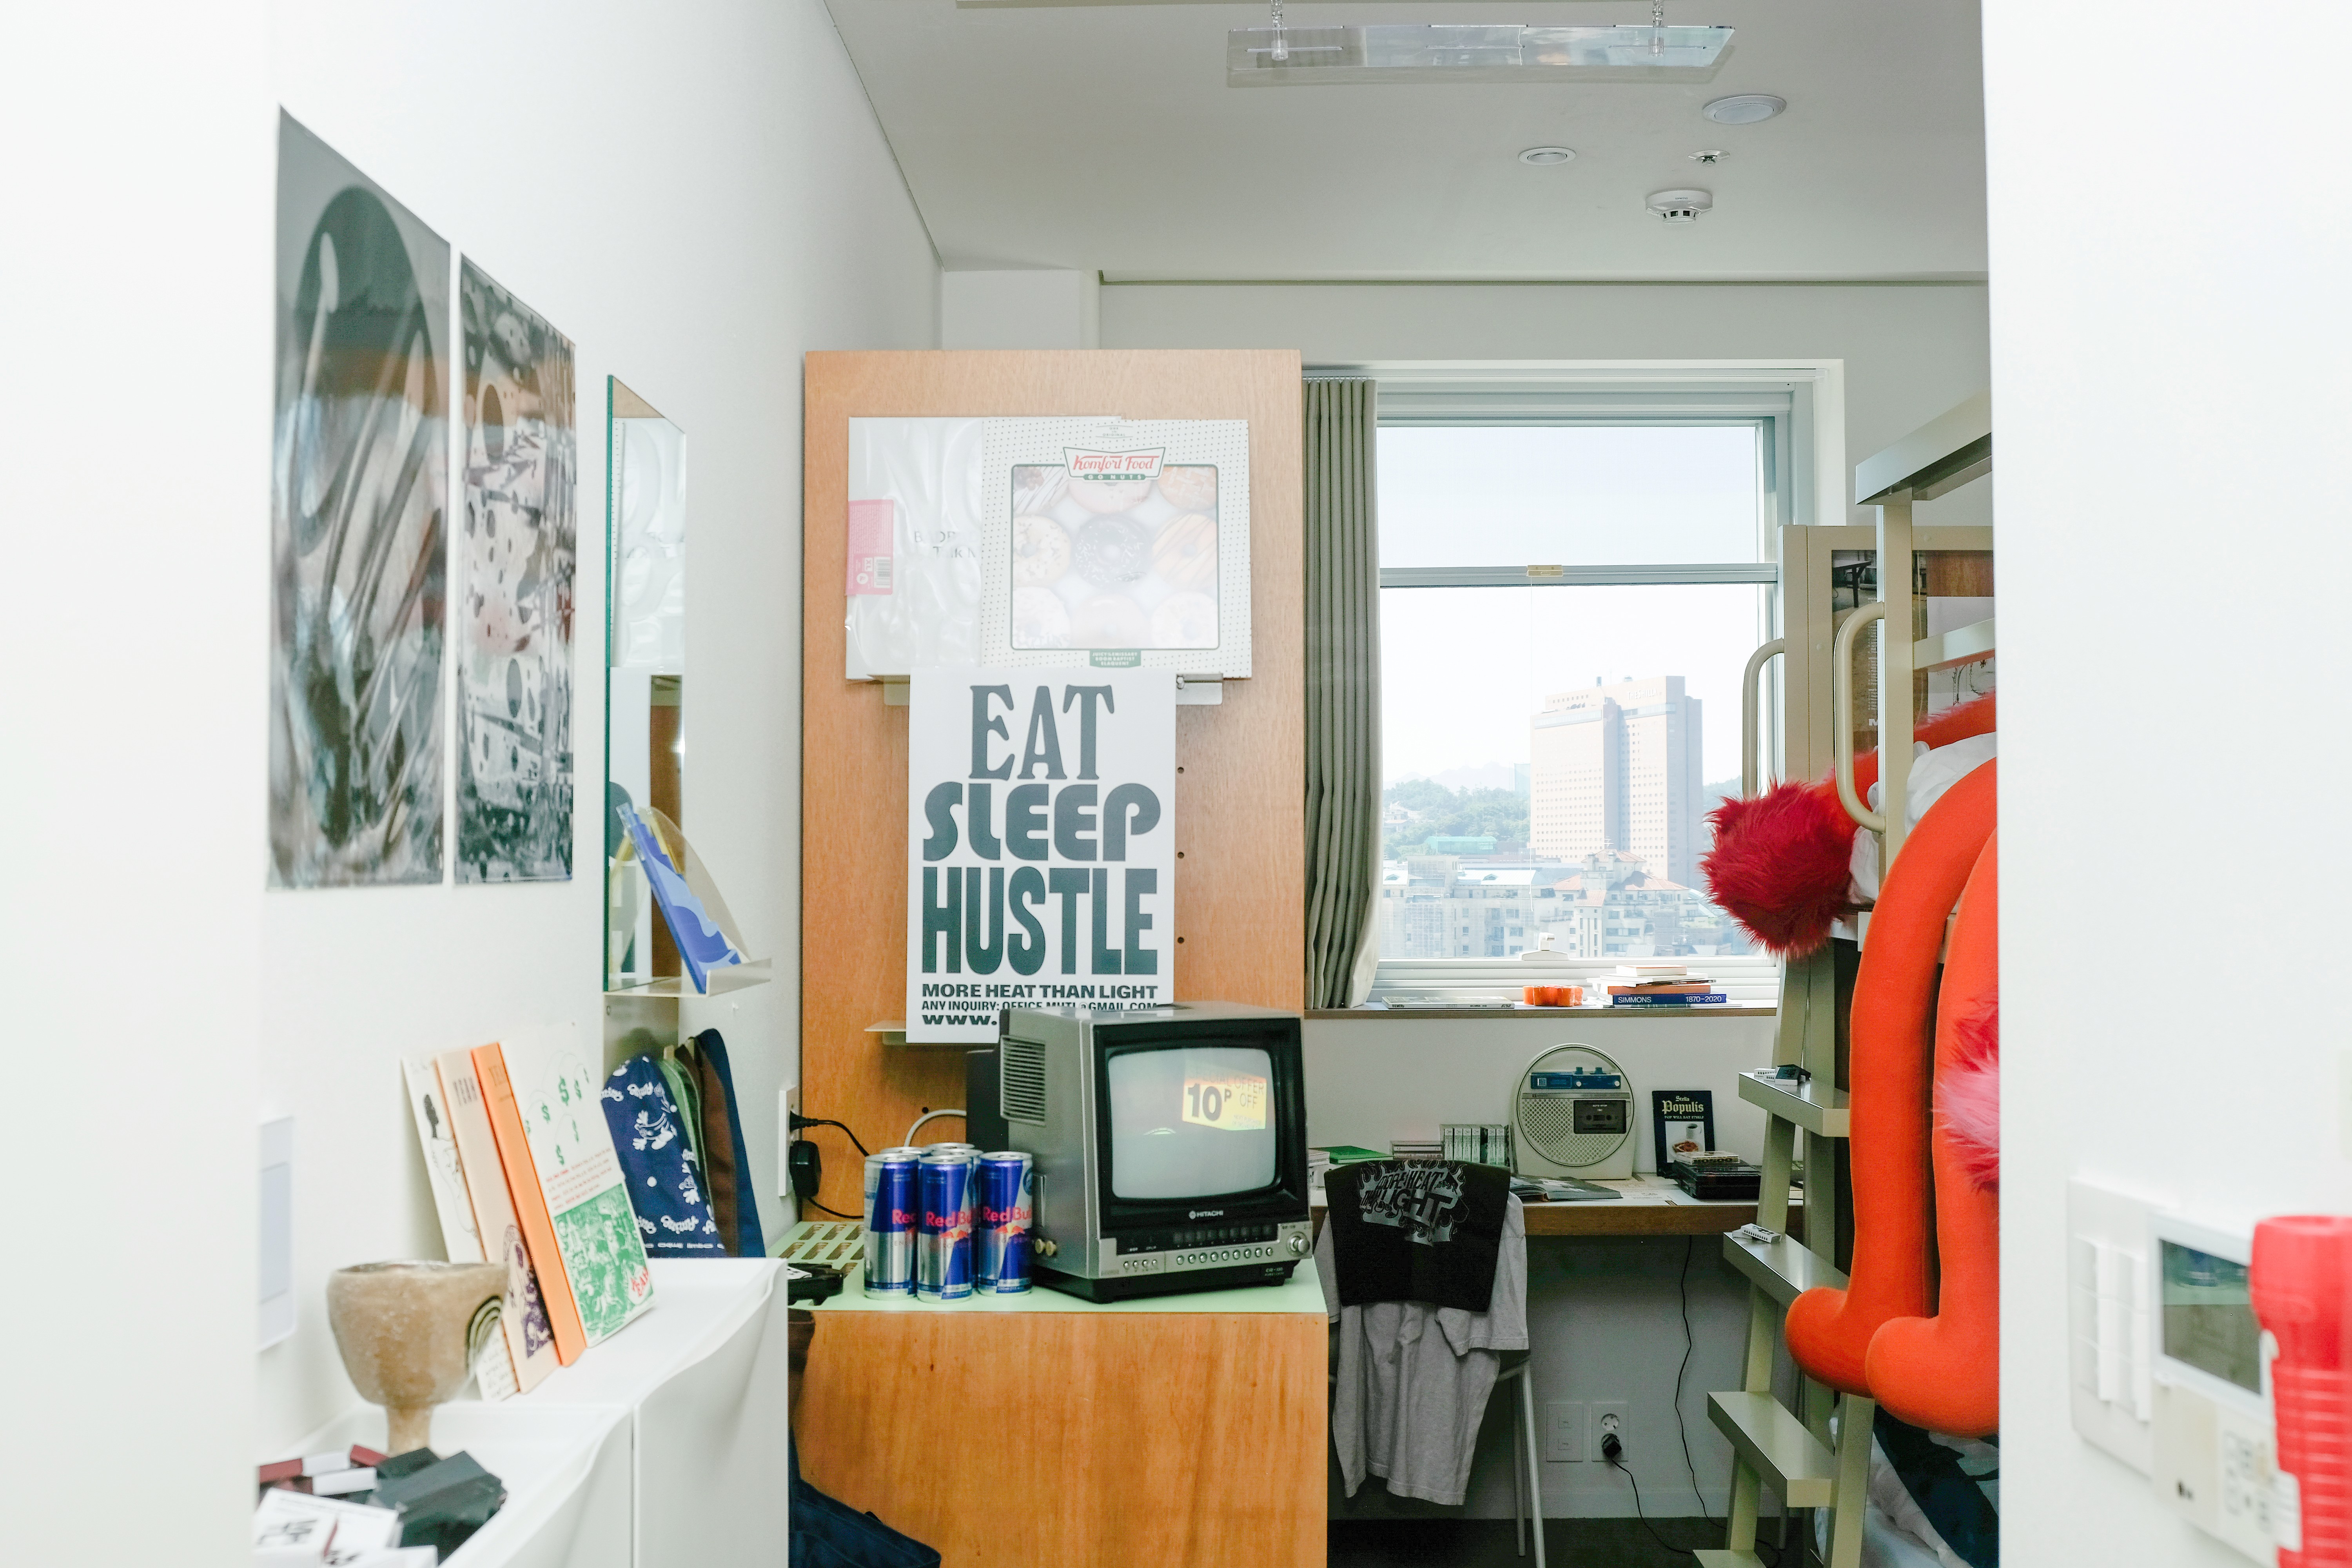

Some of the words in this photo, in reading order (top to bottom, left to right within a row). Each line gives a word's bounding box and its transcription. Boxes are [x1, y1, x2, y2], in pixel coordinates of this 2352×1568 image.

[1125, 455, 1160, 470] Food
[968, 684, 1114, 780] EAT
[923, 782, 1161, 862] SLEEP
[922, 866, 1157, 976] HUSTLE
[922, 984, 981, 997] MORE
[986, 984, 1036, 998] HEAT
[1040, 985, 1097, 998] THAN
[1099, 985, 1158, 999] LIGHT
[922, 1001, 945, 1010] ANY
[949, 1002, 999, 1012] INQUIRY:
[1234, 1076, 1264, 1095] OFFER
[1240, 1093, 1258, 1109] OFF
[926, 1211, 956, 1227] Red
[983, 1207, 1011, 1222] Red
